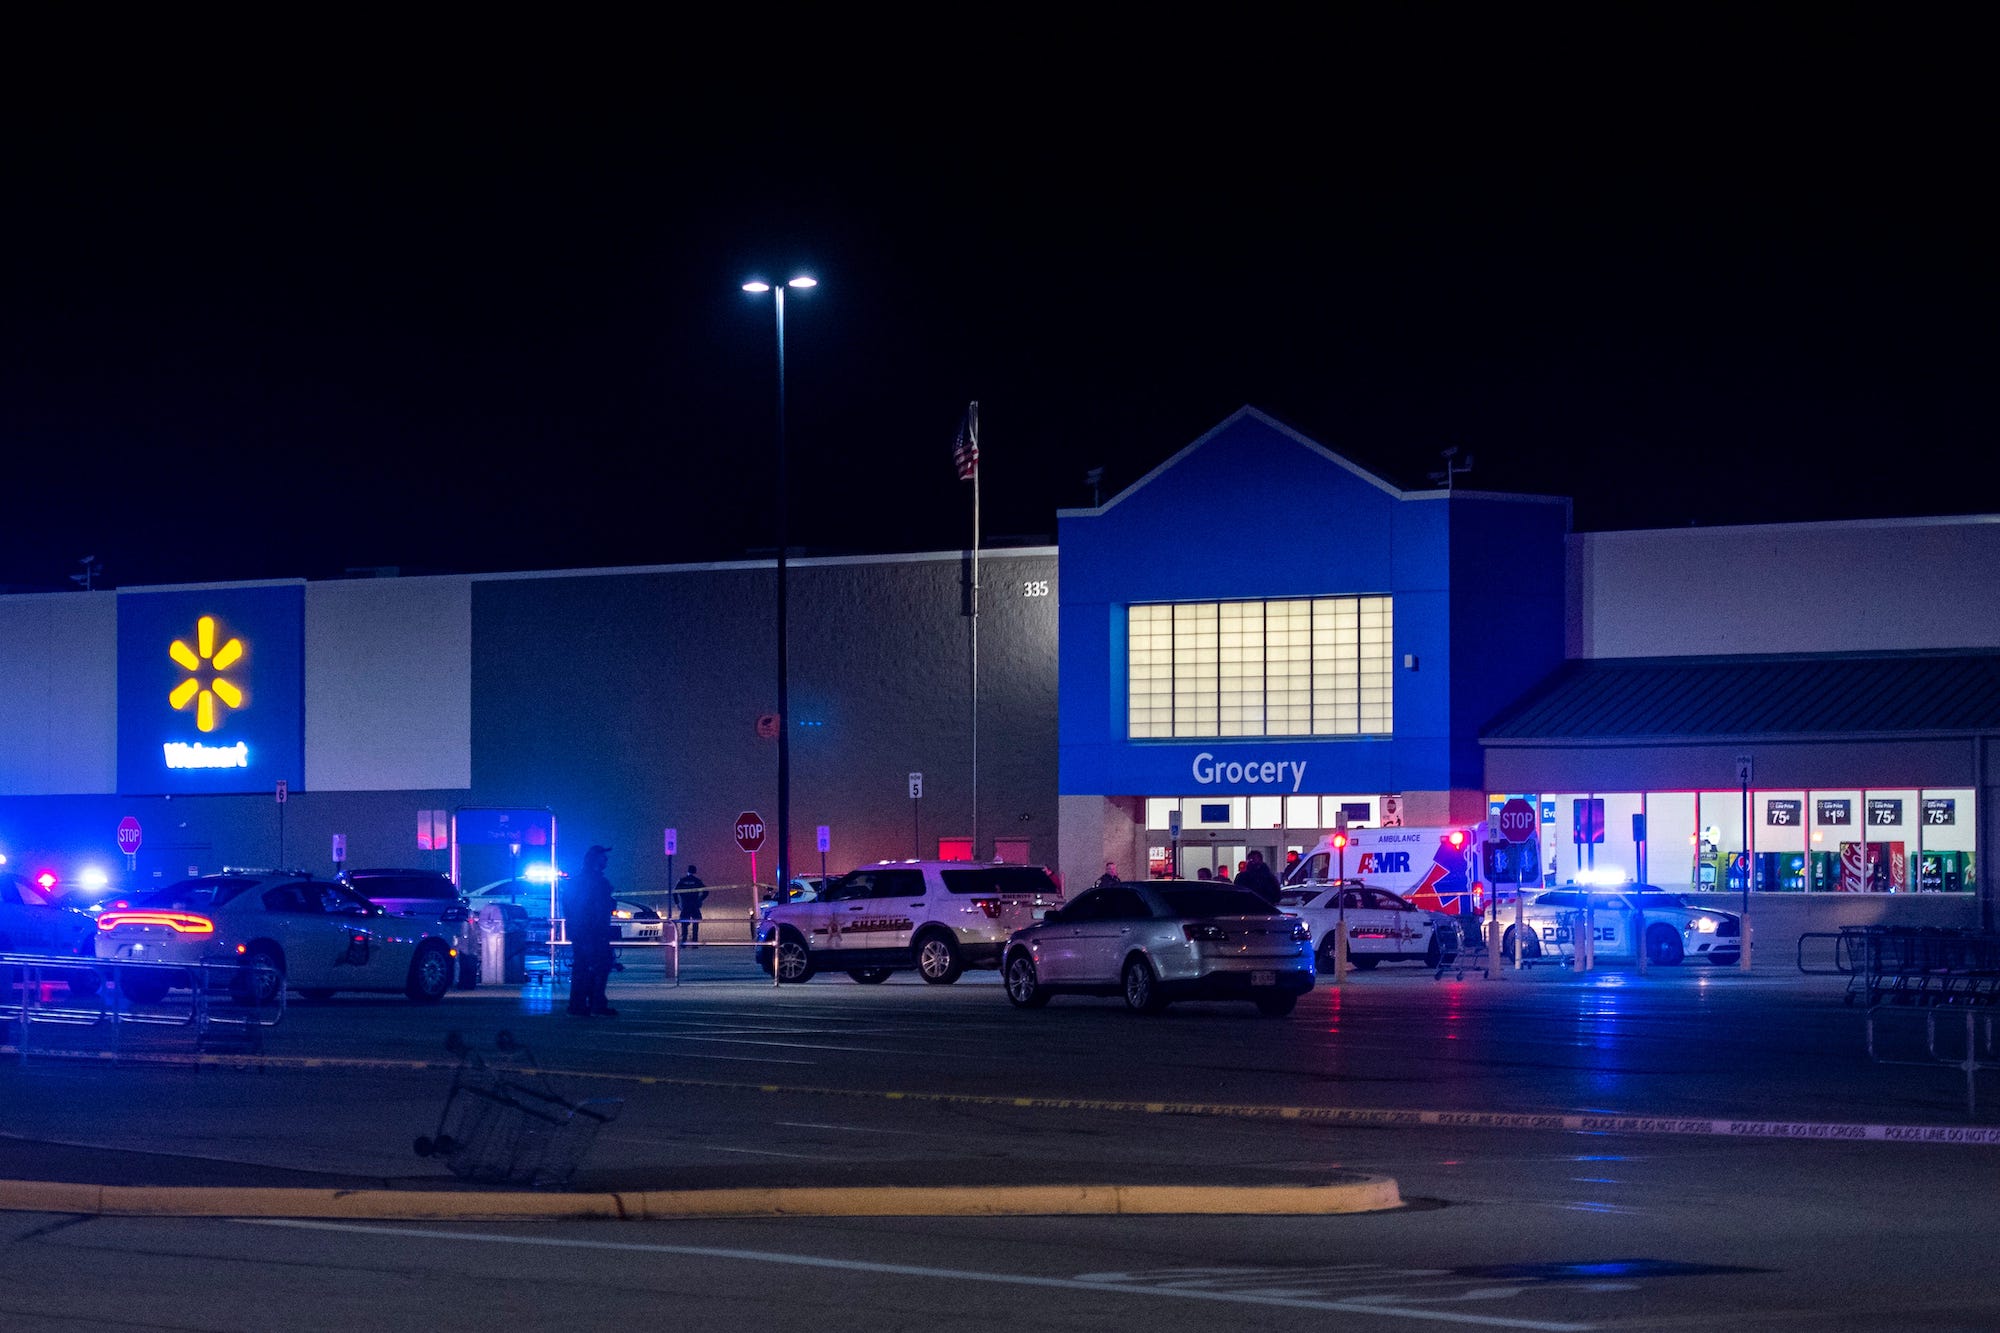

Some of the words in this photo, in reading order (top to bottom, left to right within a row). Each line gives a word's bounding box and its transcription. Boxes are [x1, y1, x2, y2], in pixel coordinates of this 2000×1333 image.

[1024, 581, 1049, 597] 335
[163, 741, 248, 769] Walmart
[1192, 752, 1308, 793] Grocery
[1741, 767, 1748, 780] 4
[278, 789, 284, 800] 6
[913, 784, 919, 796] 5
[1502, 812, 1533, 829] STOP
[119, 829, 139, 842] STOP
[736, 824, 763, 840] STOP
[1378, 834, 1421, 843] AMBULANCE
[1357, 852, 1410, 874] AMR
[852, 918, 911, 931] SHERIFF
[1543, 928, 1615, 941] POCE
[1730, 1123, 1767, 1134] POLICE
[1768, 1124, 1789, 1134] LINE
[1791, 1125, 1807, 1136] DO
[1809, 1125, 1829, 1136] NOT
[1830, 1126, 1866, 1138] CROSS
[1885, 1127, 1921, 1140] POLICE
[1923, 1128, 1946, 1141] LINE
[1947, 1129, 1963, 1141] DO
[1965, 1130, 1987, 1142] NOT
